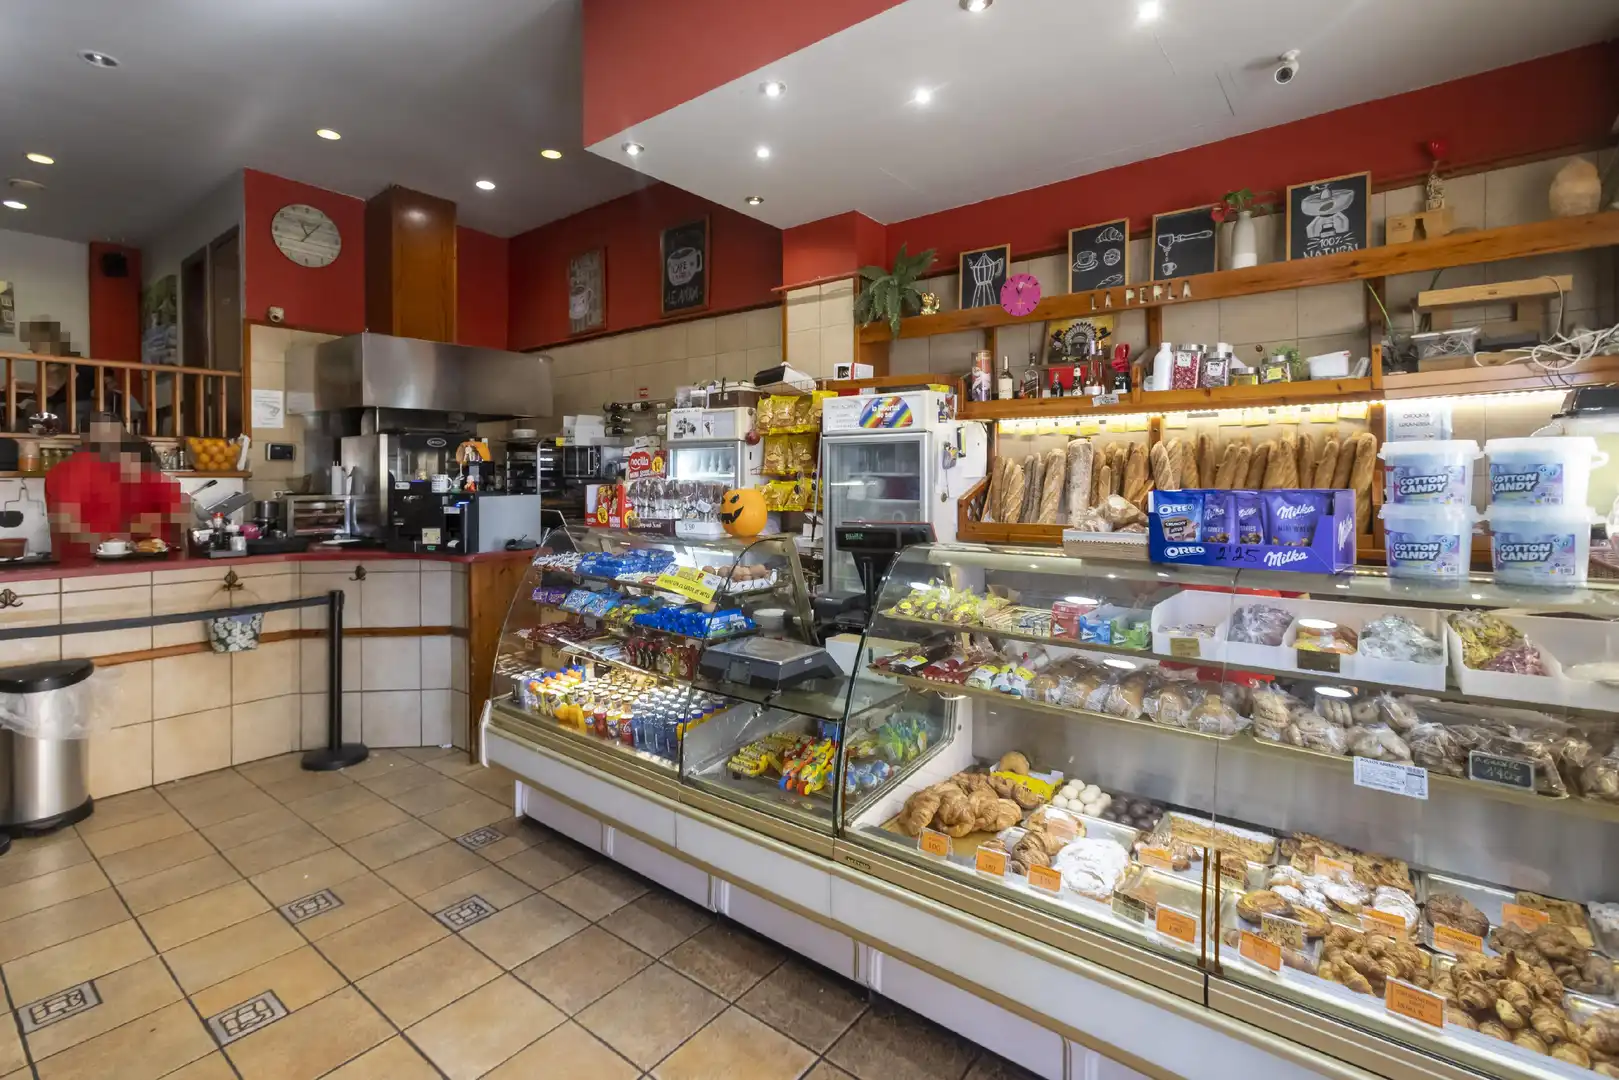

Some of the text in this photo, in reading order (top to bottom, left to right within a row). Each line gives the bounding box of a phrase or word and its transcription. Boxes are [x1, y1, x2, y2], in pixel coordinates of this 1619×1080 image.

[1320, 236, 1344, 249] 100%
[1090, 281, 1192, 310] LA PERLA
[1400, 475, 1447, 486] COTTON
[1400, 483, 1446, 494] CANDY
[1159, 504, 1194, 515] OREO
[1276, 503, 1317, 520] Milka
[1166, 546, 1205, 557] OREO
[1394, 543, 1440, 552] COTTON
[1501, 543, 1551, 552] COTTON
[1216, 546, 1260, 562] 2'25
[1264, 549, 1309, 567] Milka
[1394, 551, 1438, 560] CANDY
[1501, 552, 1550, 561] CANDY
